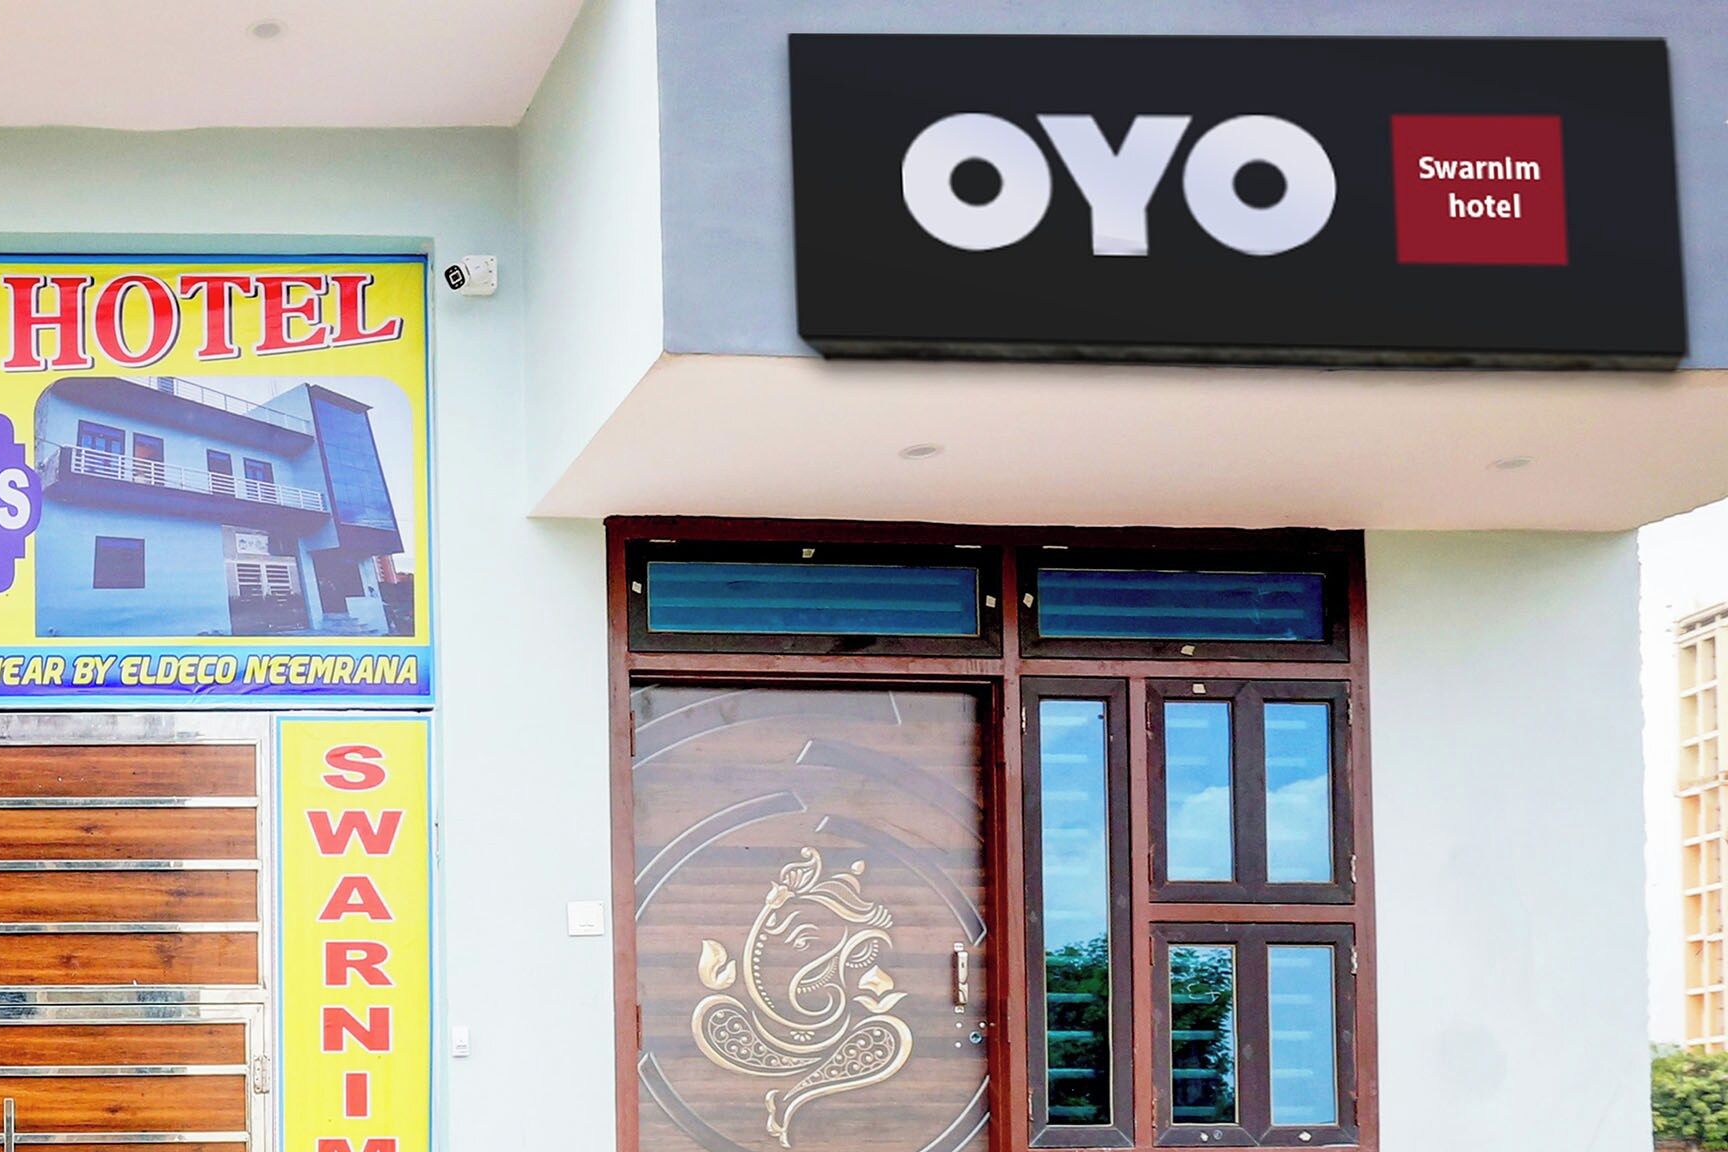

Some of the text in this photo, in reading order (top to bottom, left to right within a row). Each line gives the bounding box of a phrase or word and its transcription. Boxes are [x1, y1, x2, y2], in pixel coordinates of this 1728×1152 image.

[901, 112, 1338, 257] OYO
[1448, 192, 1522, 219] hotel
[1, 272, 402, 374] HOTEL
[72, 655, 118, 685] BY
[121, 655, 238, 685] ELDECO
[243, 655, 419, 685] NEEMRANA
